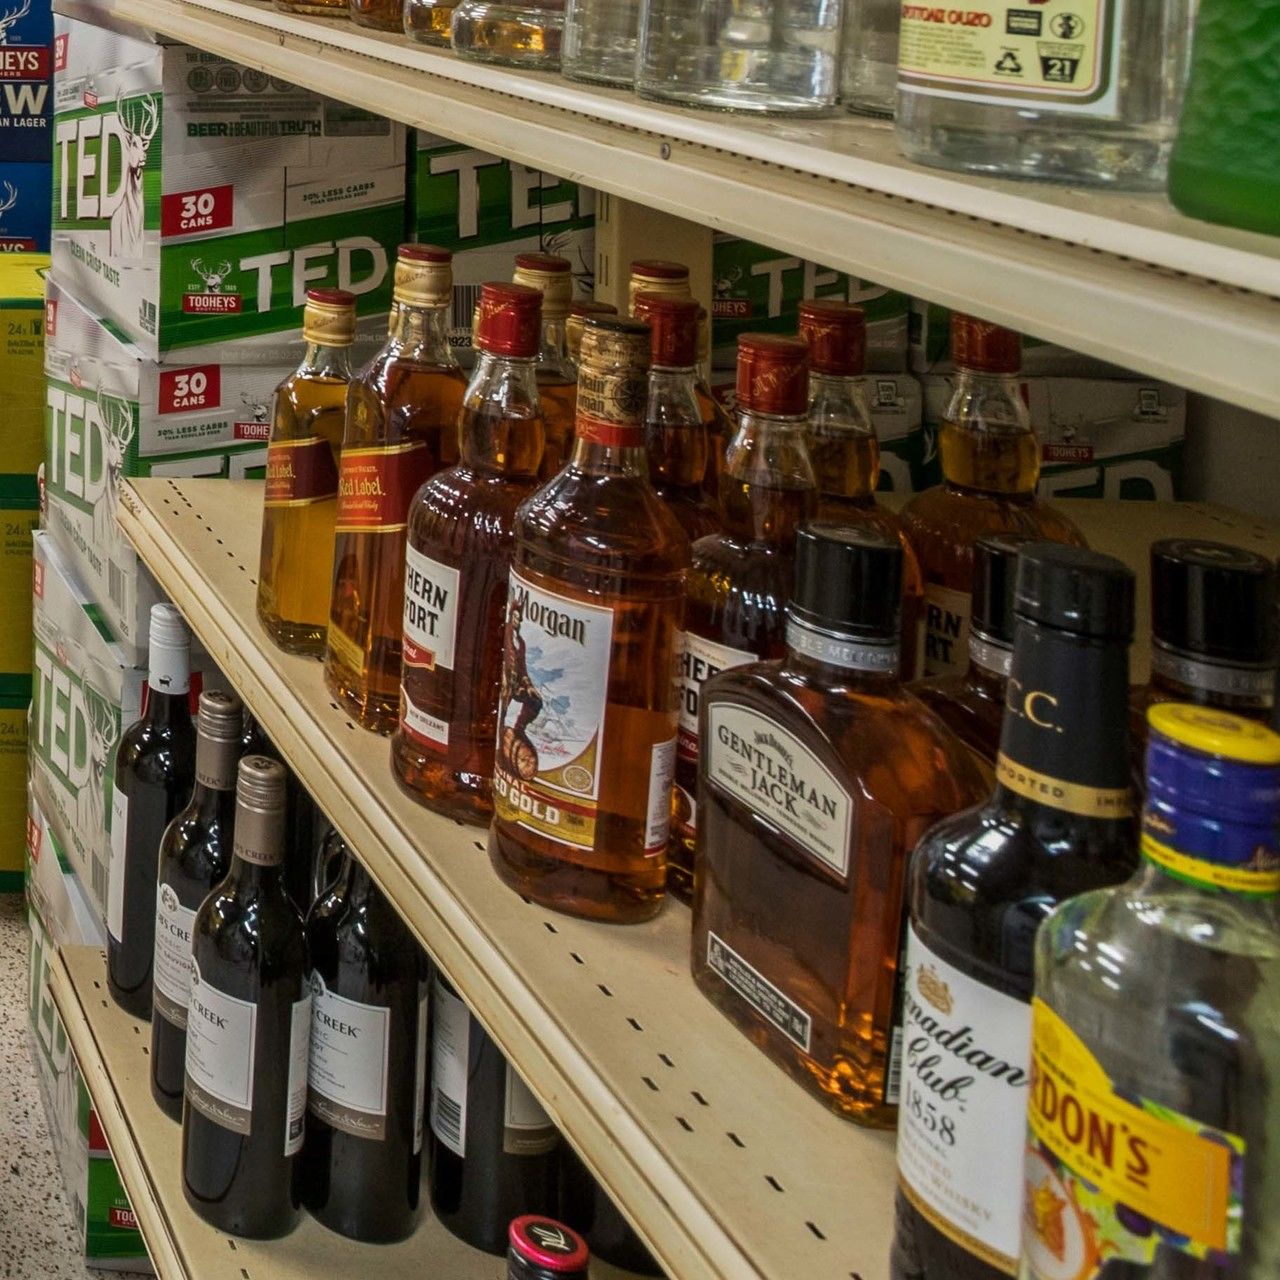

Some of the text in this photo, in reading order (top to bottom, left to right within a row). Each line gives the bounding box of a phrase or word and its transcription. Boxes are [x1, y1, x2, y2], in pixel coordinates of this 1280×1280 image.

[14, 117, 46, 128] LAGER
[241, 237, 389, 312] TED
[340, 477, 354, 496] Red
[519, 587, 587, 646] Morgan
[718, 724, 837, 820] GENTLEMAN
[749, 766, 801, 818] JACK
[508, 793, 561, 825] GOLD
[317, 1008, 359, 1038] CREEK
[904, 1084, 957, 1148] 1858
